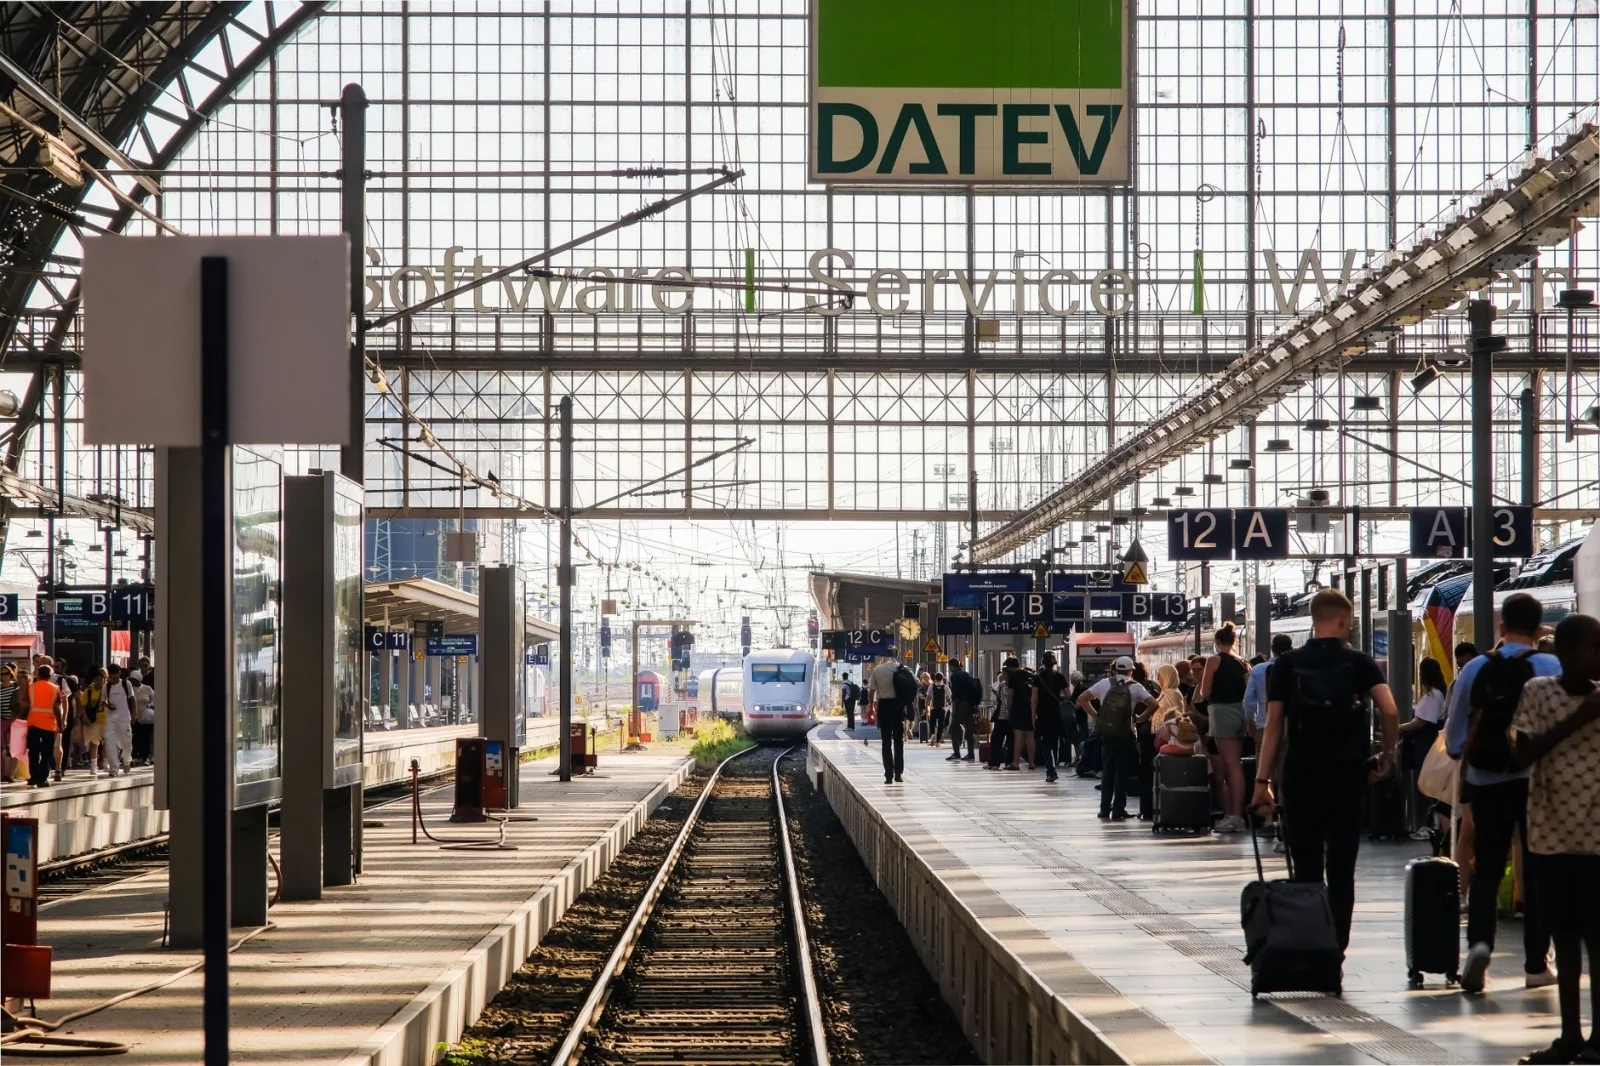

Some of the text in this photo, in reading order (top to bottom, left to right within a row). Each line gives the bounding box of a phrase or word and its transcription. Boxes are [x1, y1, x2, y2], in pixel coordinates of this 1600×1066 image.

[817, 102, 1123, 175] DATEV
[806, 247, 1134, 317] Service
[1174, 511, 1272, 548] 12 A
[1427, 508, 1517, 547] A 3
[92, 594, 141, 614] B 11
[991, 594, 1044, 616] 12 B
[1133, 594, 1185, 616] B 13
[372, 632, 405, 646] C 11
[847, 630, 881, 644] 12 C
